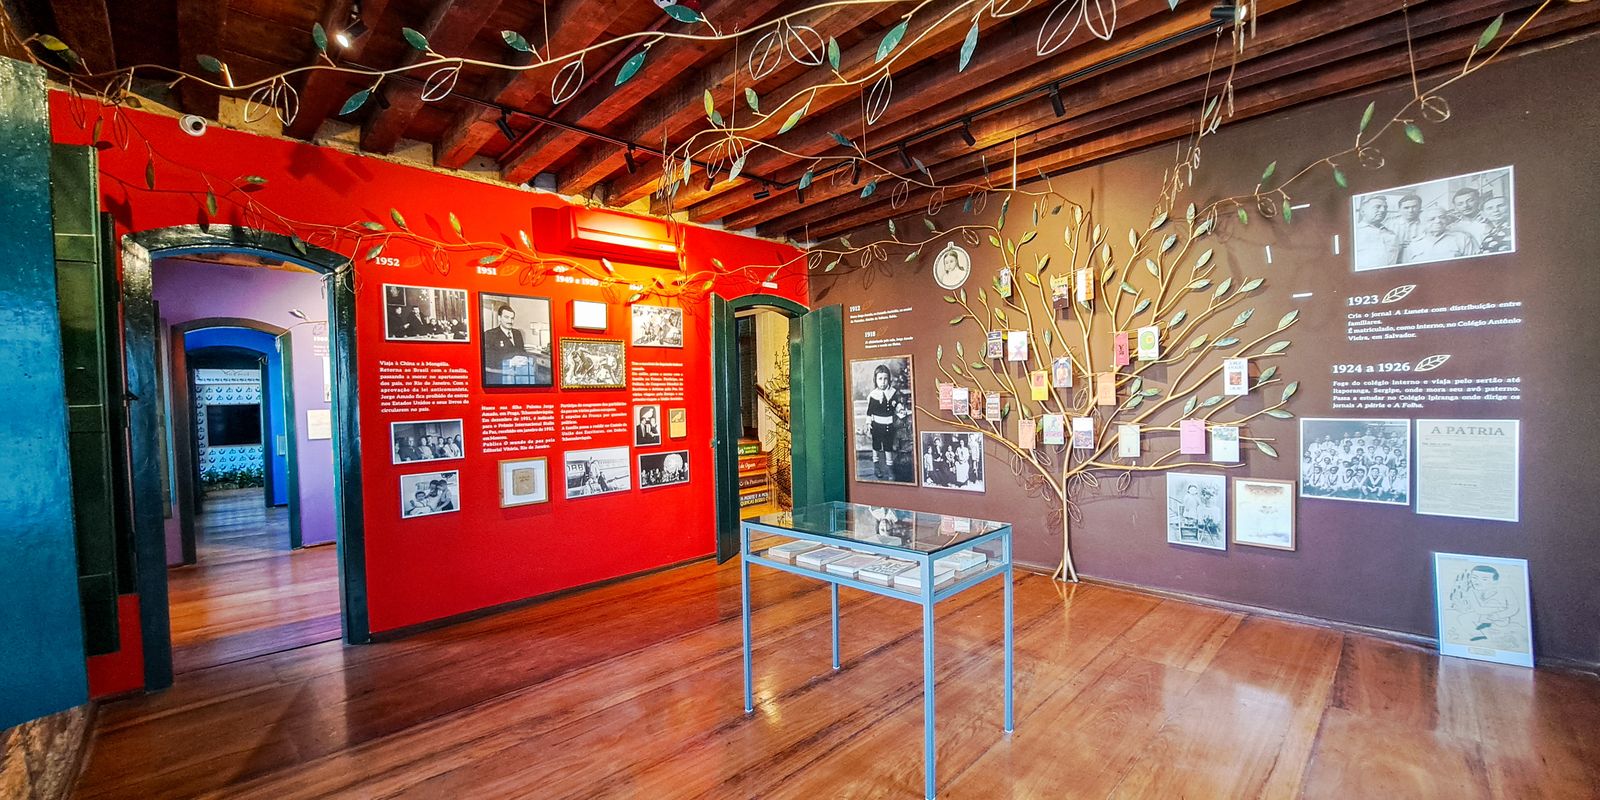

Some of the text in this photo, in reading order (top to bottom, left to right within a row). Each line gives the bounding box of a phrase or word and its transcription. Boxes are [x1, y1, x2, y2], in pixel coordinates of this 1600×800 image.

[376, 256, 400, 266] 1952
[476, 266, 496, 275] 1951
[556, 275, 574, 284] 1949
[1348, 294, 1379, 306] 1923
[1333, 364, 1362, 374] 1924
[1378, 362, 1411, 372] 1926
[1446, 426, 1504, 436] PATRIA
